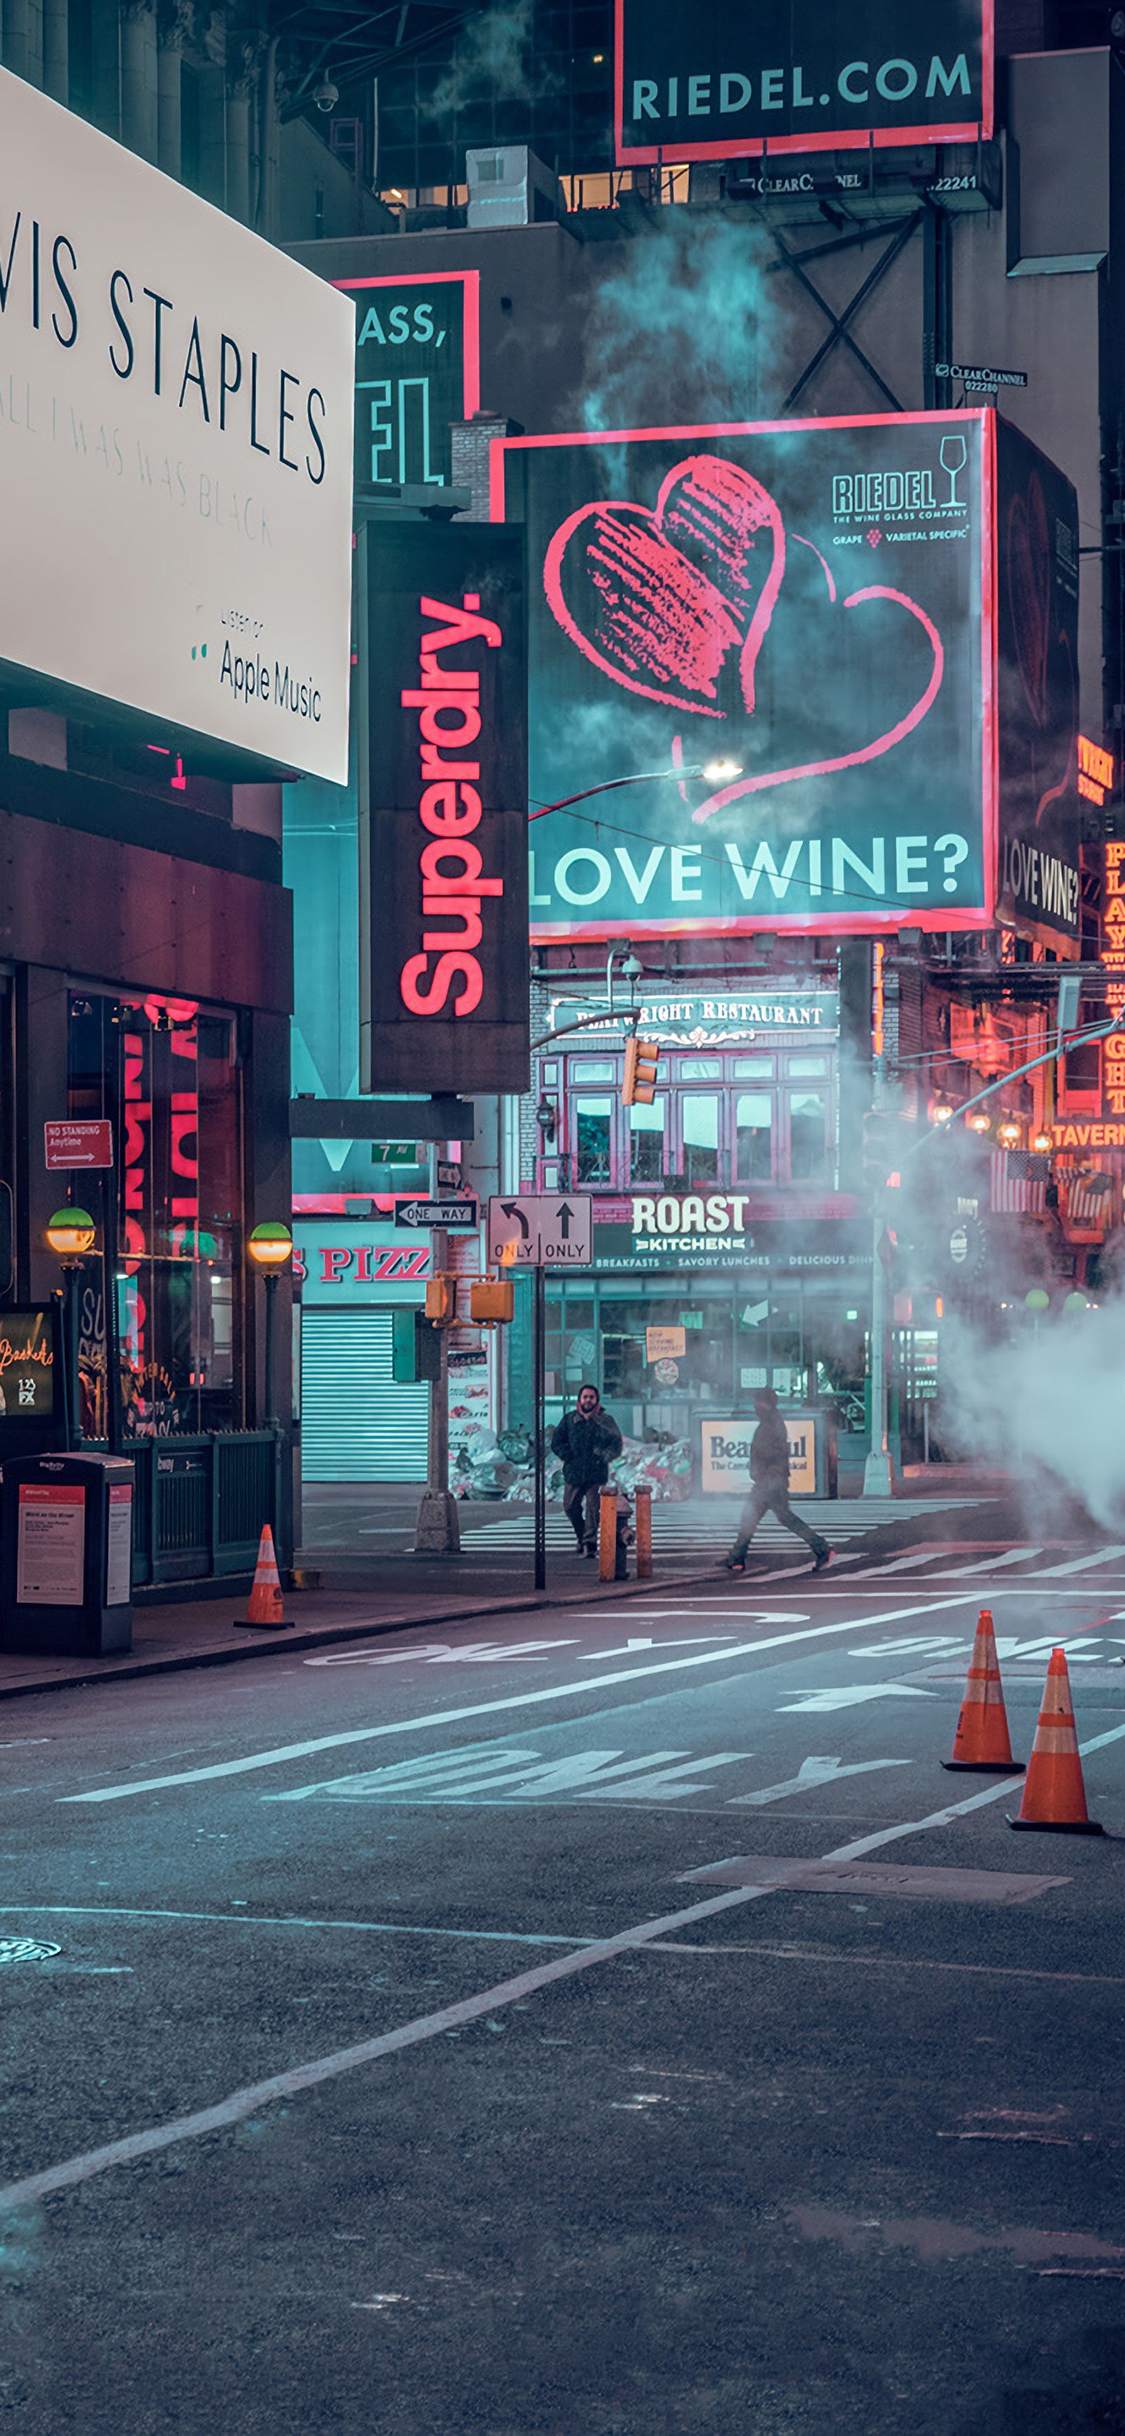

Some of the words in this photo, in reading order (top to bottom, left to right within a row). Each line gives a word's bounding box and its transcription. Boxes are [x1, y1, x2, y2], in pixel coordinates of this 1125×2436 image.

[632, 53, 973, 121] RIEDEL.COM
[108, 269, 326, 485] STAPLES
[832, 470, 937, 514] RIEDEL
[833, 515, 850, 523] THE
[853, 513, 880, 523] WINE
[884, 511, 915, 521] GLASS
[918, 509, 968, 520] COMPANY
[832, 534, 862, 545] GRAPE
[885, 531, 927, 542] VARIETAL
[220, 639, 270, 703] Apple
[273, 660, 322, 723] Music
[402, 593, 503, 1018] Superdry.
[529, 844, 703, 905] LOVE
[724, 833, 970, 902] WINE?
[1003, 834, 1039, 906] LOVE
[1040, 851, 1079, 926] WINE?
[701, 1000, 823, 1026] RESTAURANT
[379, 1145, 391, 1161] 7
[407, 1208, 430, 1220] ONE
[441, 1208, 467, 1220] WAY
[631, 1196, 750, 1234] ROAST
[494, 1244, 534, 1258] ONLY
[545, 1244, 585, 1258] ONLY
[649, 1238, 733, 1251] KITCHEN
[596, 1258, 660, 1268] BREAKFASTS
[678, 1256, 720, 1267] SAVORY
[721, 1256, 770, 1266] LUNCHES
[789, 1256, 846, 1266] DELICIOUS
